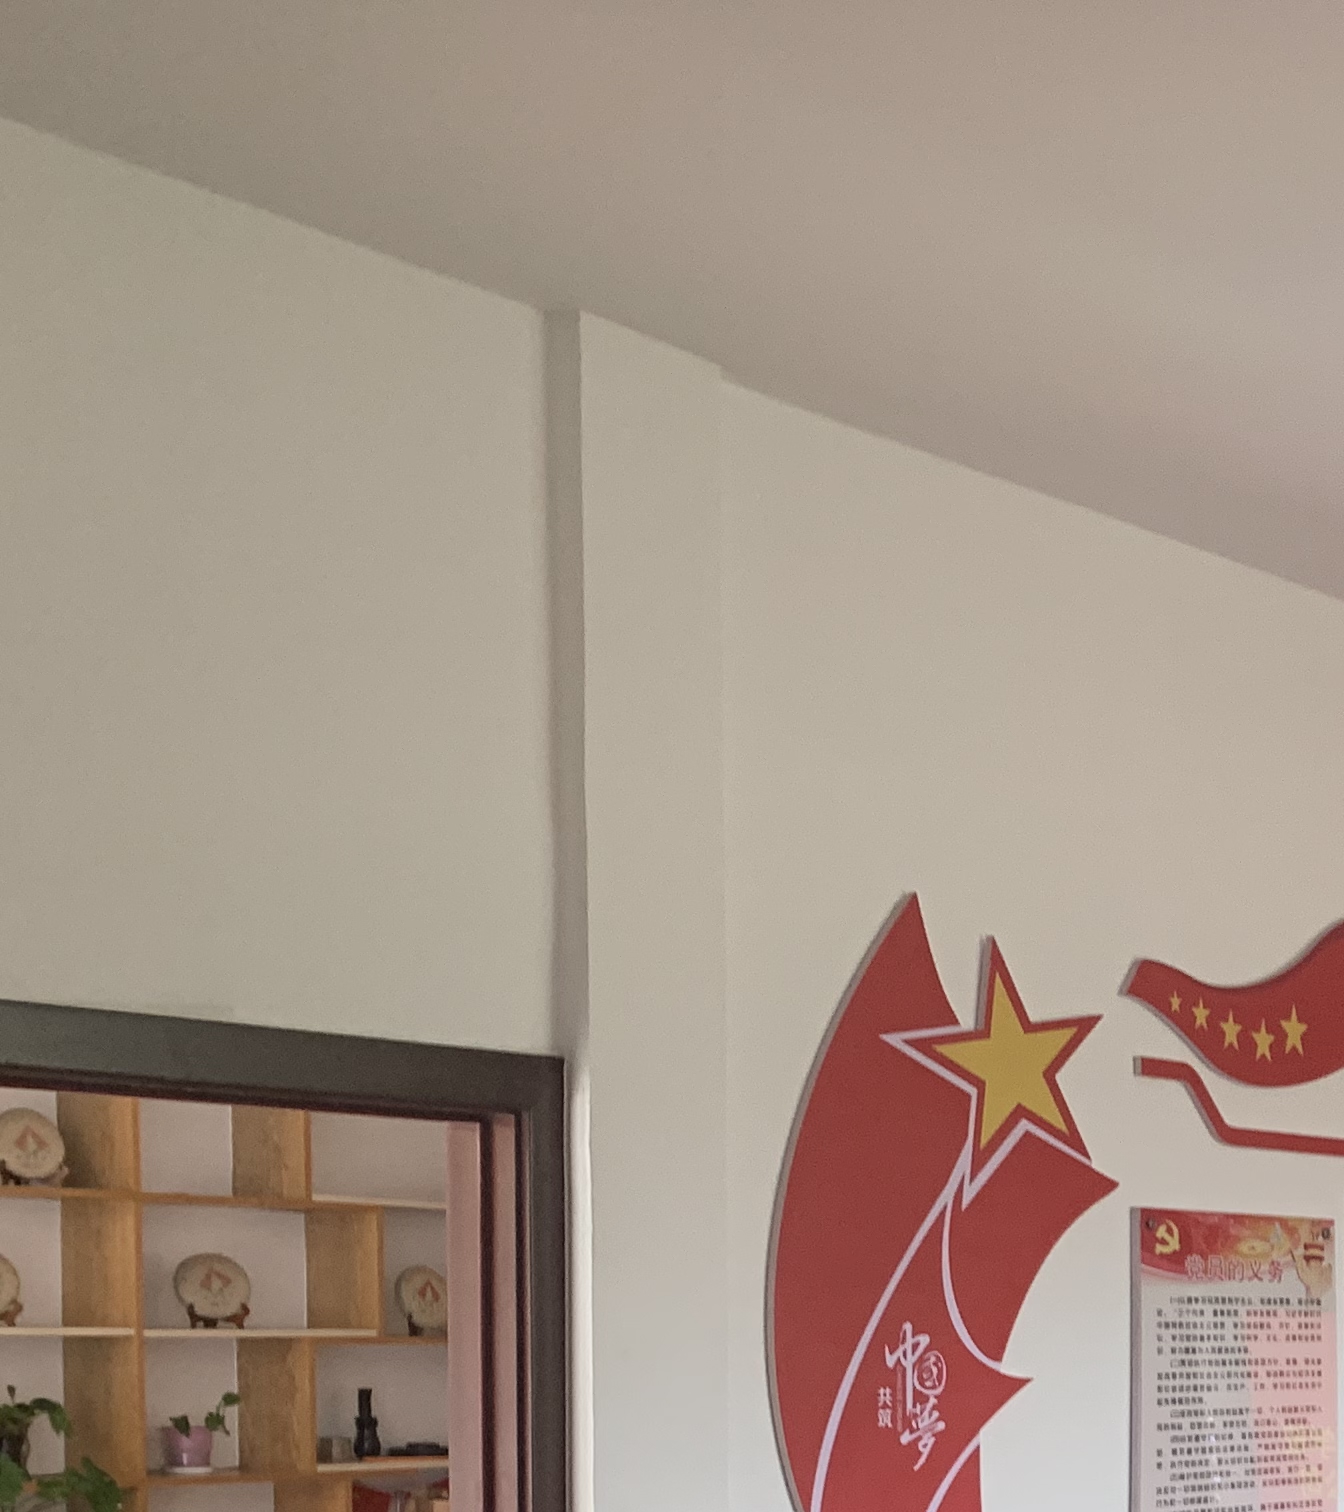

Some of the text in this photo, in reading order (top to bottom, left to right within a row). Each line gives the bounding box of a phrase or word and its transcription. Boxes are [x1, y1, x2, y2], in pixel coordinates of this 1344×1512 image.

[1184, 1253, 1284, 1284] 党员的义务
[877, 1386, 893, 1429] 共筑
